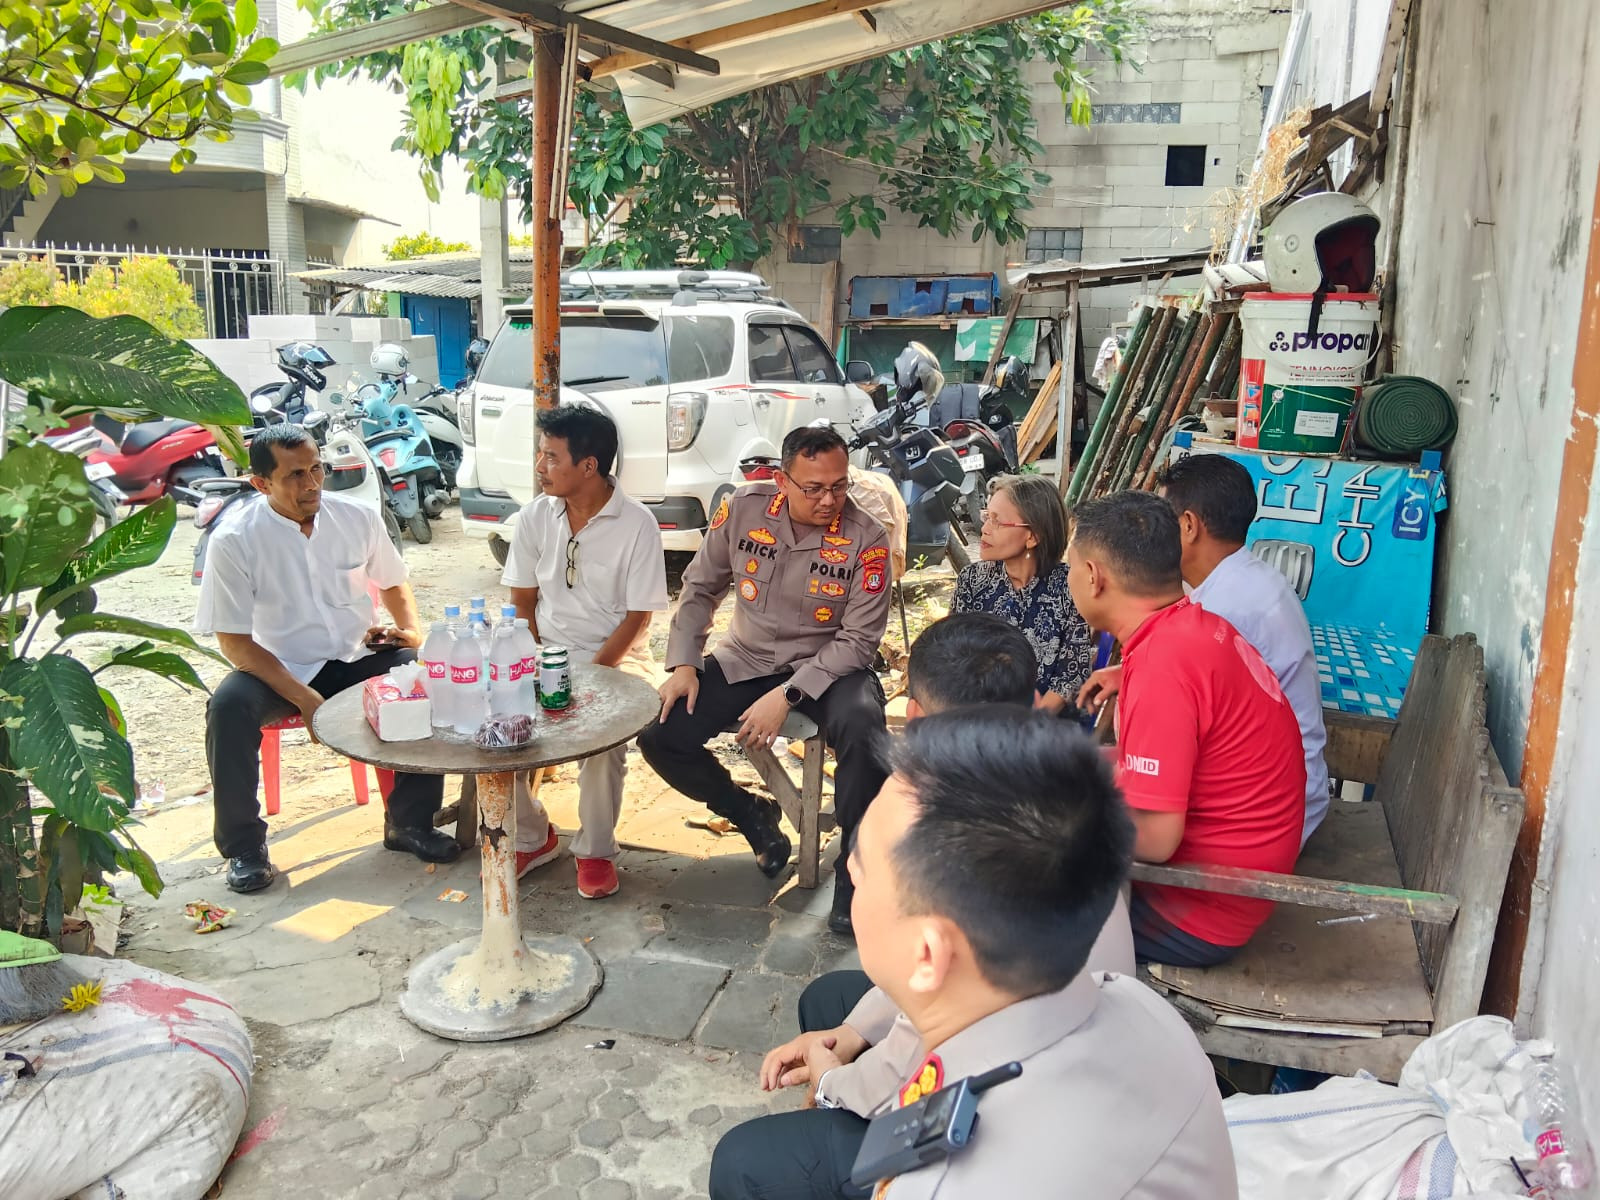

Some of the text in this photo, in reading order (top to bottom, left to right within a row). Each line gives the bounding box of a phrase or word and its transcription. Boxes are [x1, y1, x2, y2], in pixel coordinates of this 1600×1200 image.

[1398, 486, 1426, 534] ICY
[738, 538, 778, 561] ERICK
[810, 561, 851, 580] POLRI
[425, 663, 444, 674] NO
